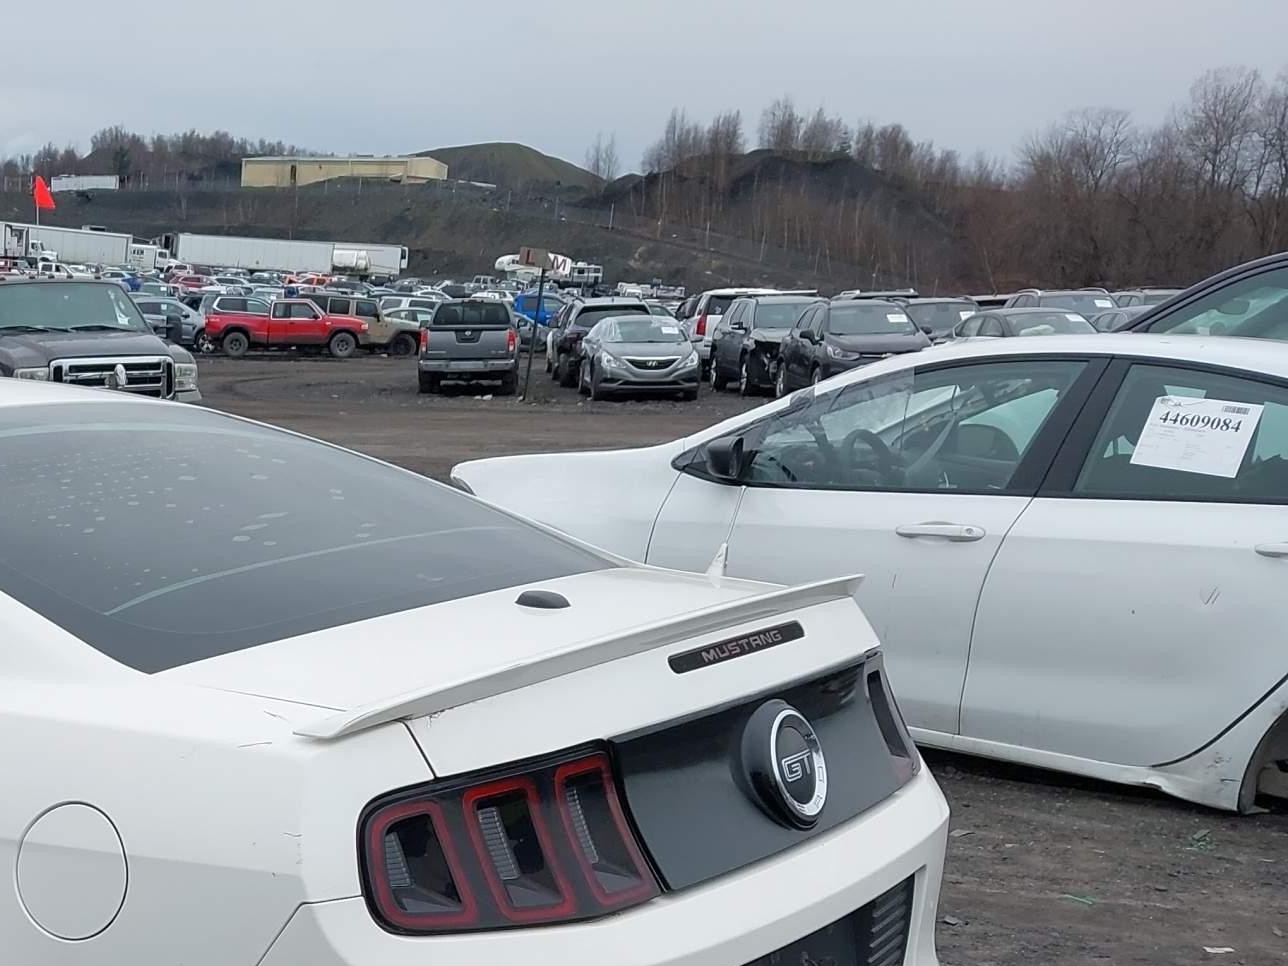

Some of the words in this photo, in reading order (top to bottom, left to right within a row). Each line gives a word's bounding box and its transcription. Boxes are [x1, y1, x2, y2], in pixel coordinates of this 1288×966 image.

[525, 249, 536, 266] L
[552, 255, 568, 272] M
[1159, 410, 1242, 433] 44609084
[701, 629, 783, 662] MUSTANG
[781, 748, 811, 782] GT
